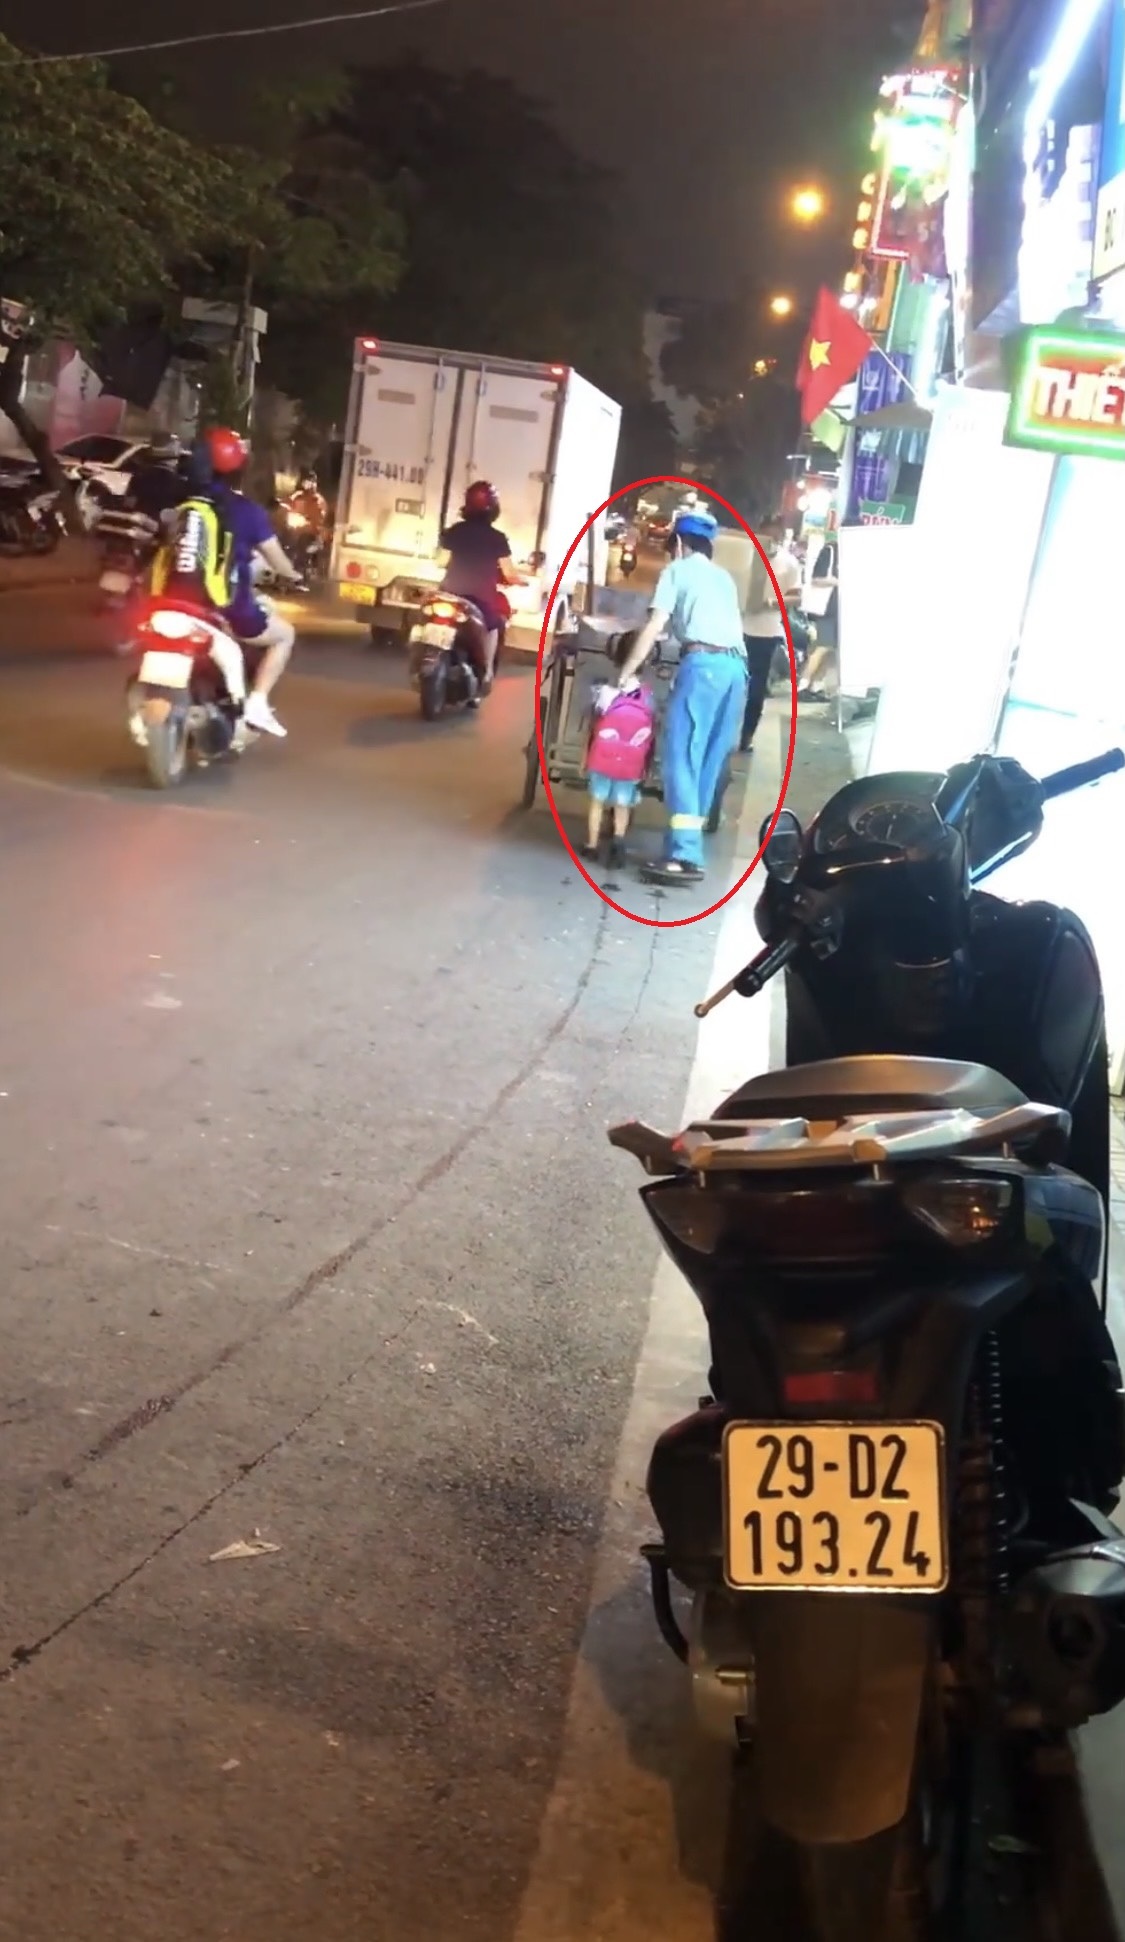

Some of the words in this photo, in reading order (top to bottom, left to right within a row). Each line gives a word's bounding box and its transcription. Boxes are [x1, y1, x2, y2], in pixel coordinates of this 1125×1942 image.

[1031, 352, 1125, 426] THIẾ
[756, 1434, 909, 1500] 29-D2
[743, 1510, 931, 1577] 193.24
